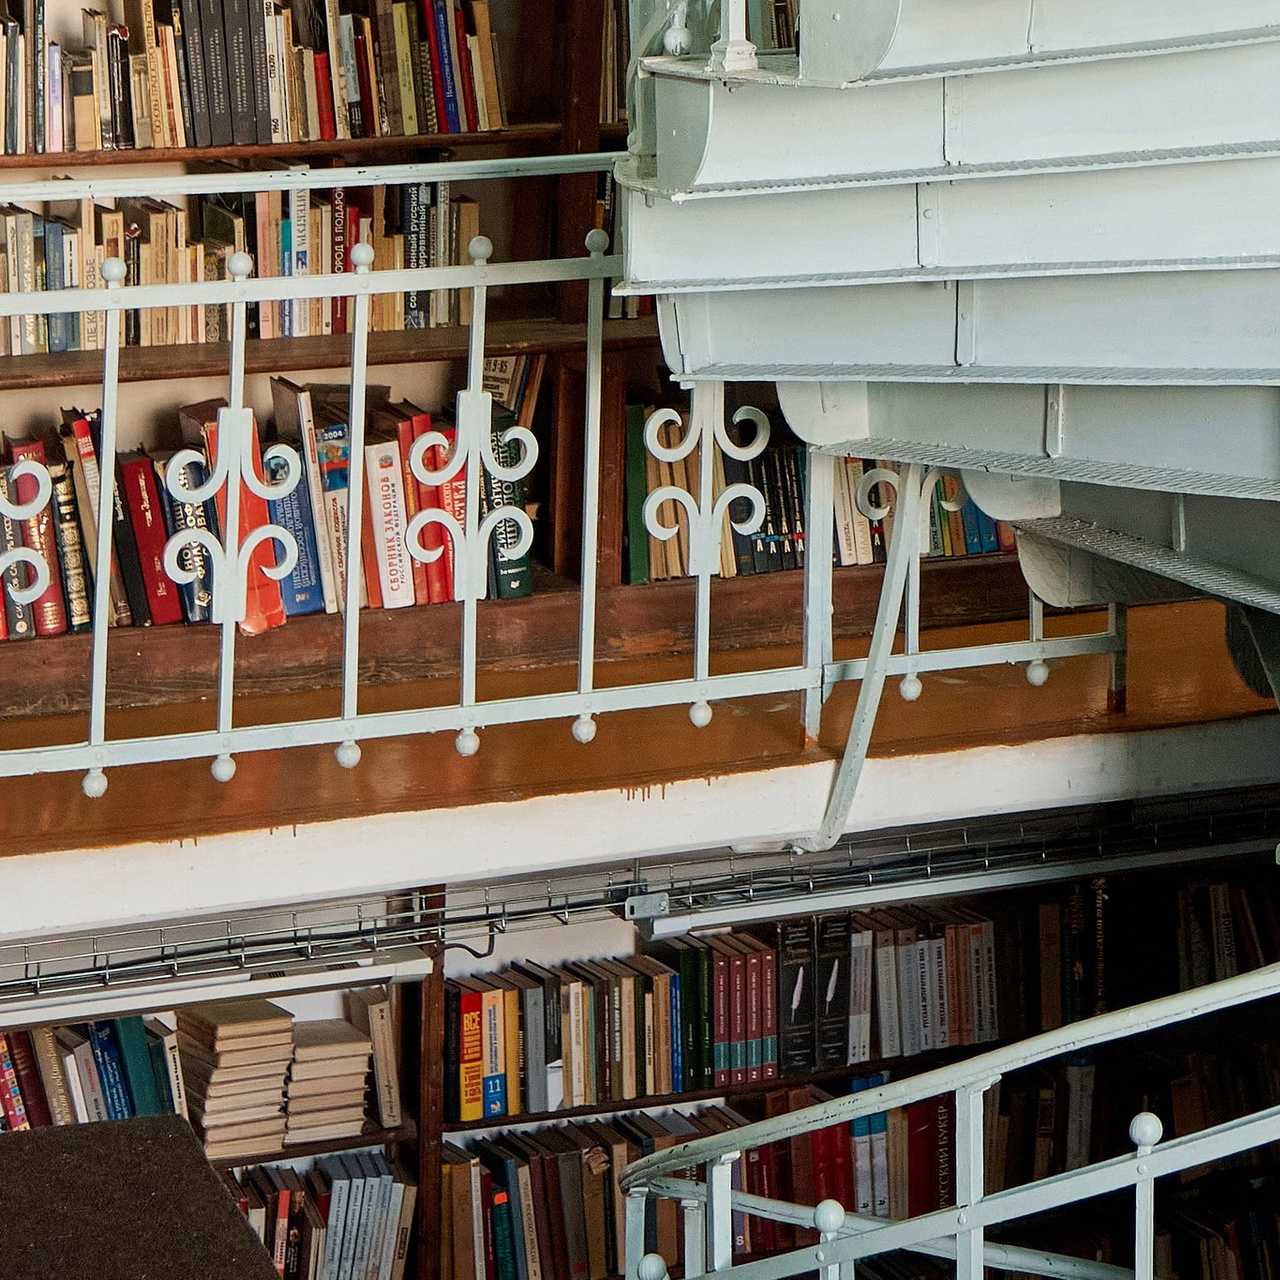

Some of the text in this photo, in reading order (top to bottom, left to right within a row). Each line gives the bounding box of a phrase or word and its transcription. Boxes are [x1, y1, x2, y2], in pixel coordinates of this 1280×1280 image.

[143, 0, 158, 97] ГРАДОСТРОИТЕЛЬСТВА
[264, 1, 279, 134] 1960 СТЕКЛО 1980
[445, 65, 454, 98] Искусство
[295, 188, 307, 247] ХИТЕКТУРА
[408, 187, 419, 308] совенный русский
[418, 205, 428, 269] деревянный
[324, 430, 345, 439] 2004
[275, 499, 286, 526] ЛОВАР
[291, 492, 310, 587] ОЛЬШОЙ РОССИЙСКИЙ
[380, 476, 401, 591] СБОРНИК ЗАКОНОВ
[390, 482, 405, 585] РОССИЙСКОЙ ФЕДЕРАЦИИ
[463, 1011, 480, 1031] ВСЕ
[487, 1078, 502, 1094] 11
[936, 1104, 953, 1210] РУССКИЙ БУКЕР
